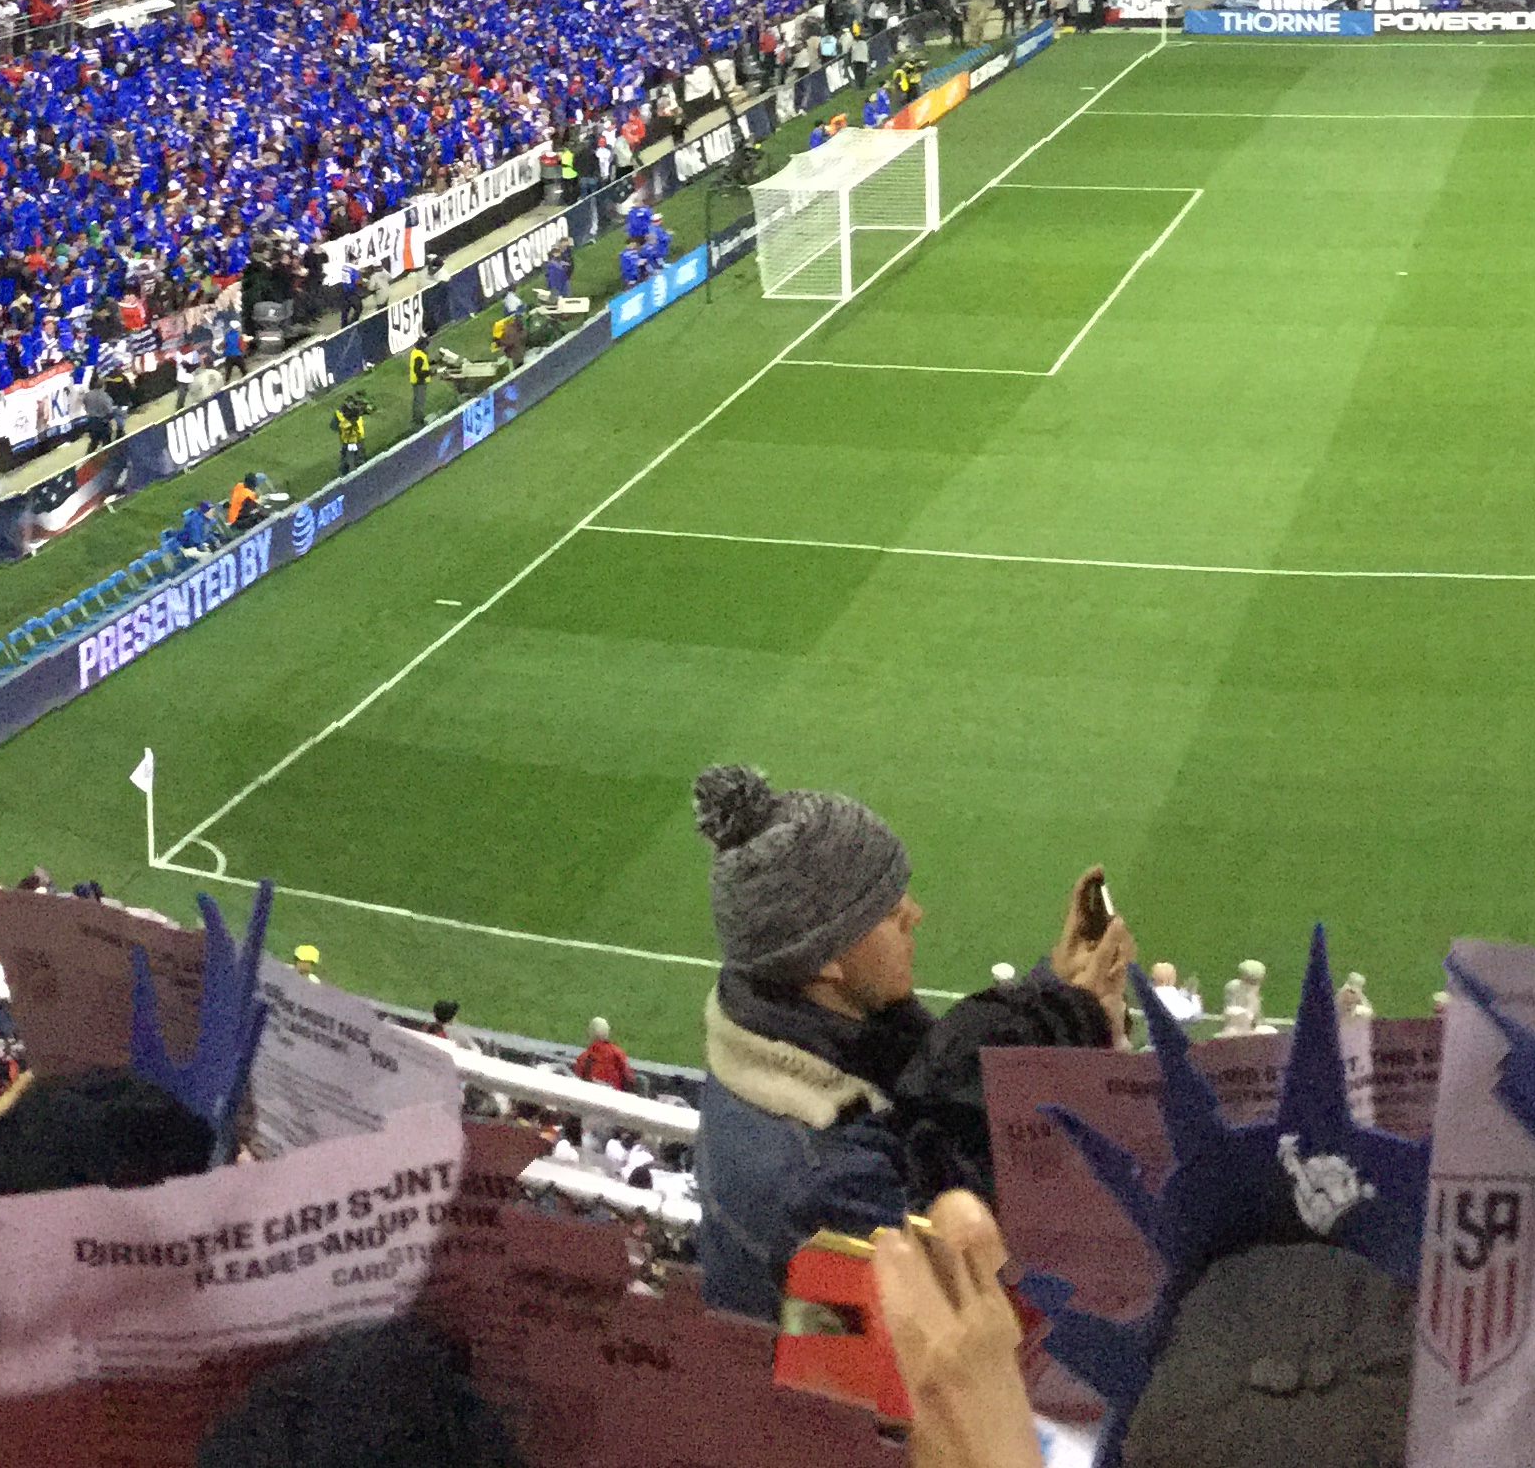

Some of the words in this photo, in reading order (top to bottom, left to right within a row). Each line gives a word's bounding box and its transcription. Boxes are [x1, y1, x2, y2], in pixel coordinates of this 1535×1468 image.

[478, 258, 509, 299] UN
[166, 399, 229, 466] UNA
[78, 557, 235, 691] PRESENTED
[239, 529, 274, 589] BY
